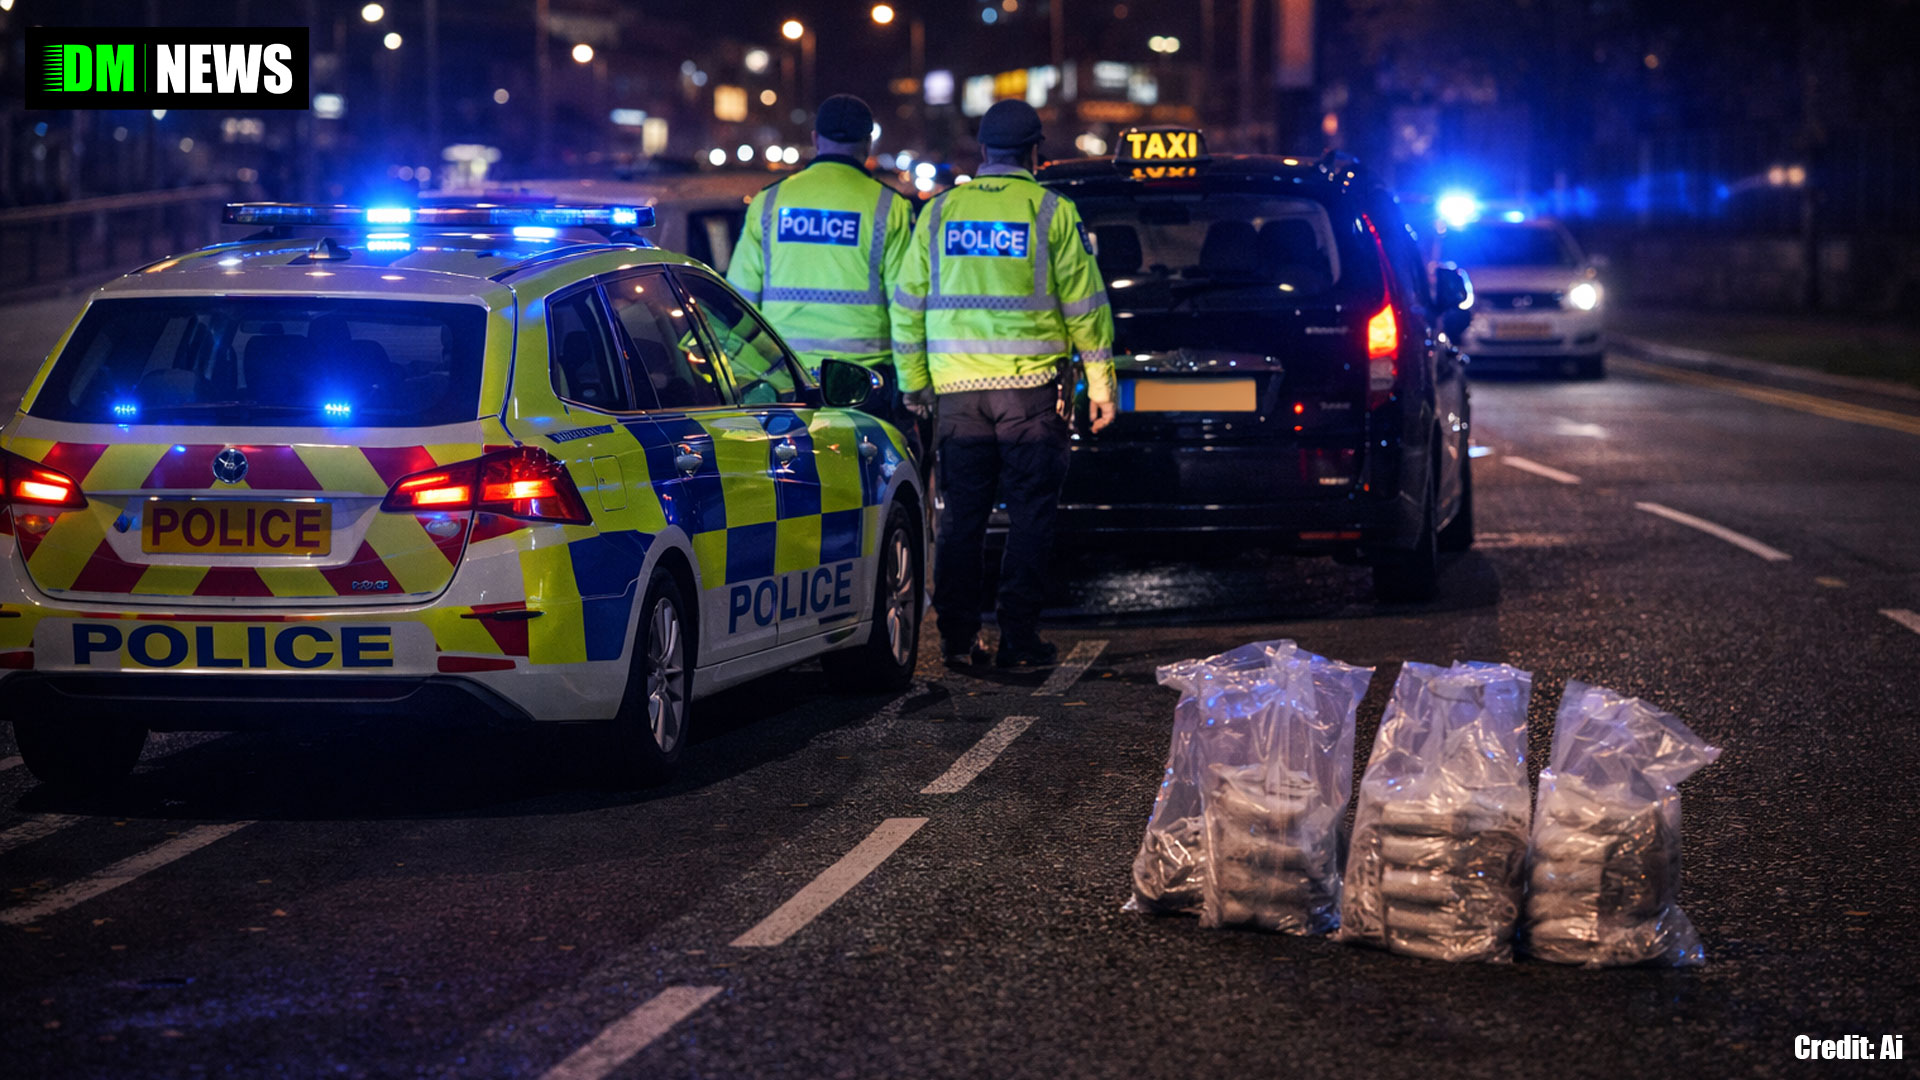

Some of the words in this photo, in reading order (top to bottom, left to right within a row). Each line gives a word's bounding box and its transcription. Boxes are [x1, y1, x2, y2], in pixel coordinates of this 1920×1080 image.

[1126, 132, 1198, 159] TAXI
[780, 216, 857, 239] POLICE
[947, 229, 1026, 250] POLICE
[151, 507, 322, 548] POLICE
[728, 561, 854, 635] POLICE
[72, 623, 394, 669] POLICE
